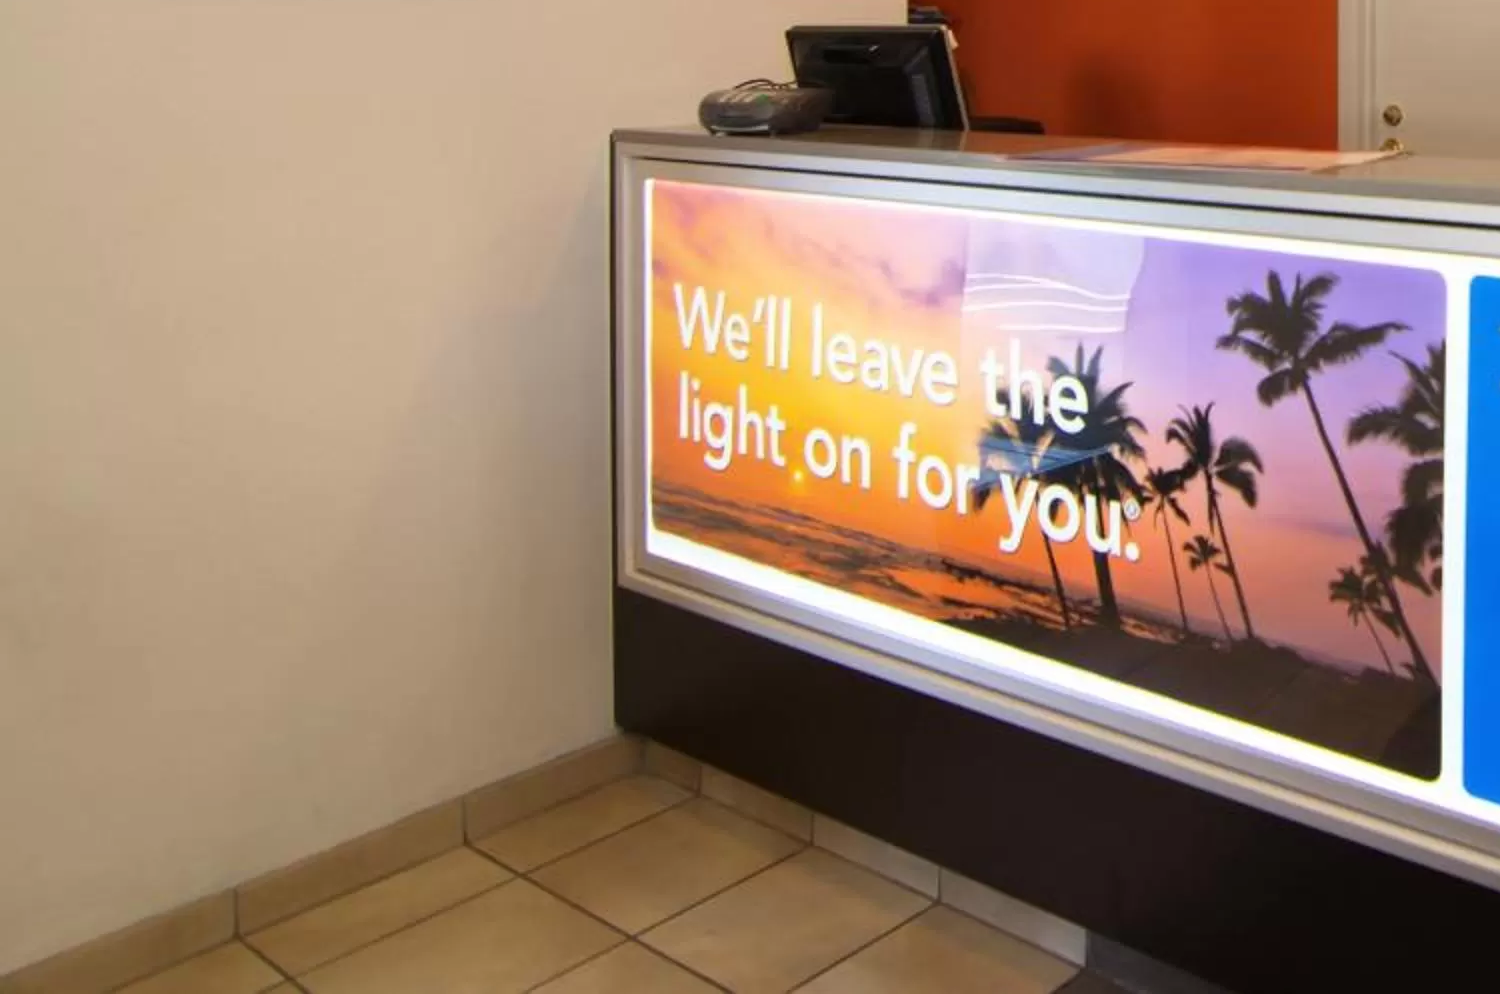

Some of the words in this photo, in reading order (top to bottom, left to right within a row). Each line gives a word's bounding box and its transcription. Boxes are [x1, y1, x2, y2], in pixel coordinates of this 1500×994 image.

[673, 281, 792, 371] We'll
[810, 301, 958, 405] leave
[979, 338, 1090, 433] the
[678, 370, 786, 471] light
[803, 427, 871, 490] on
[892, 421, 981, 516] for
